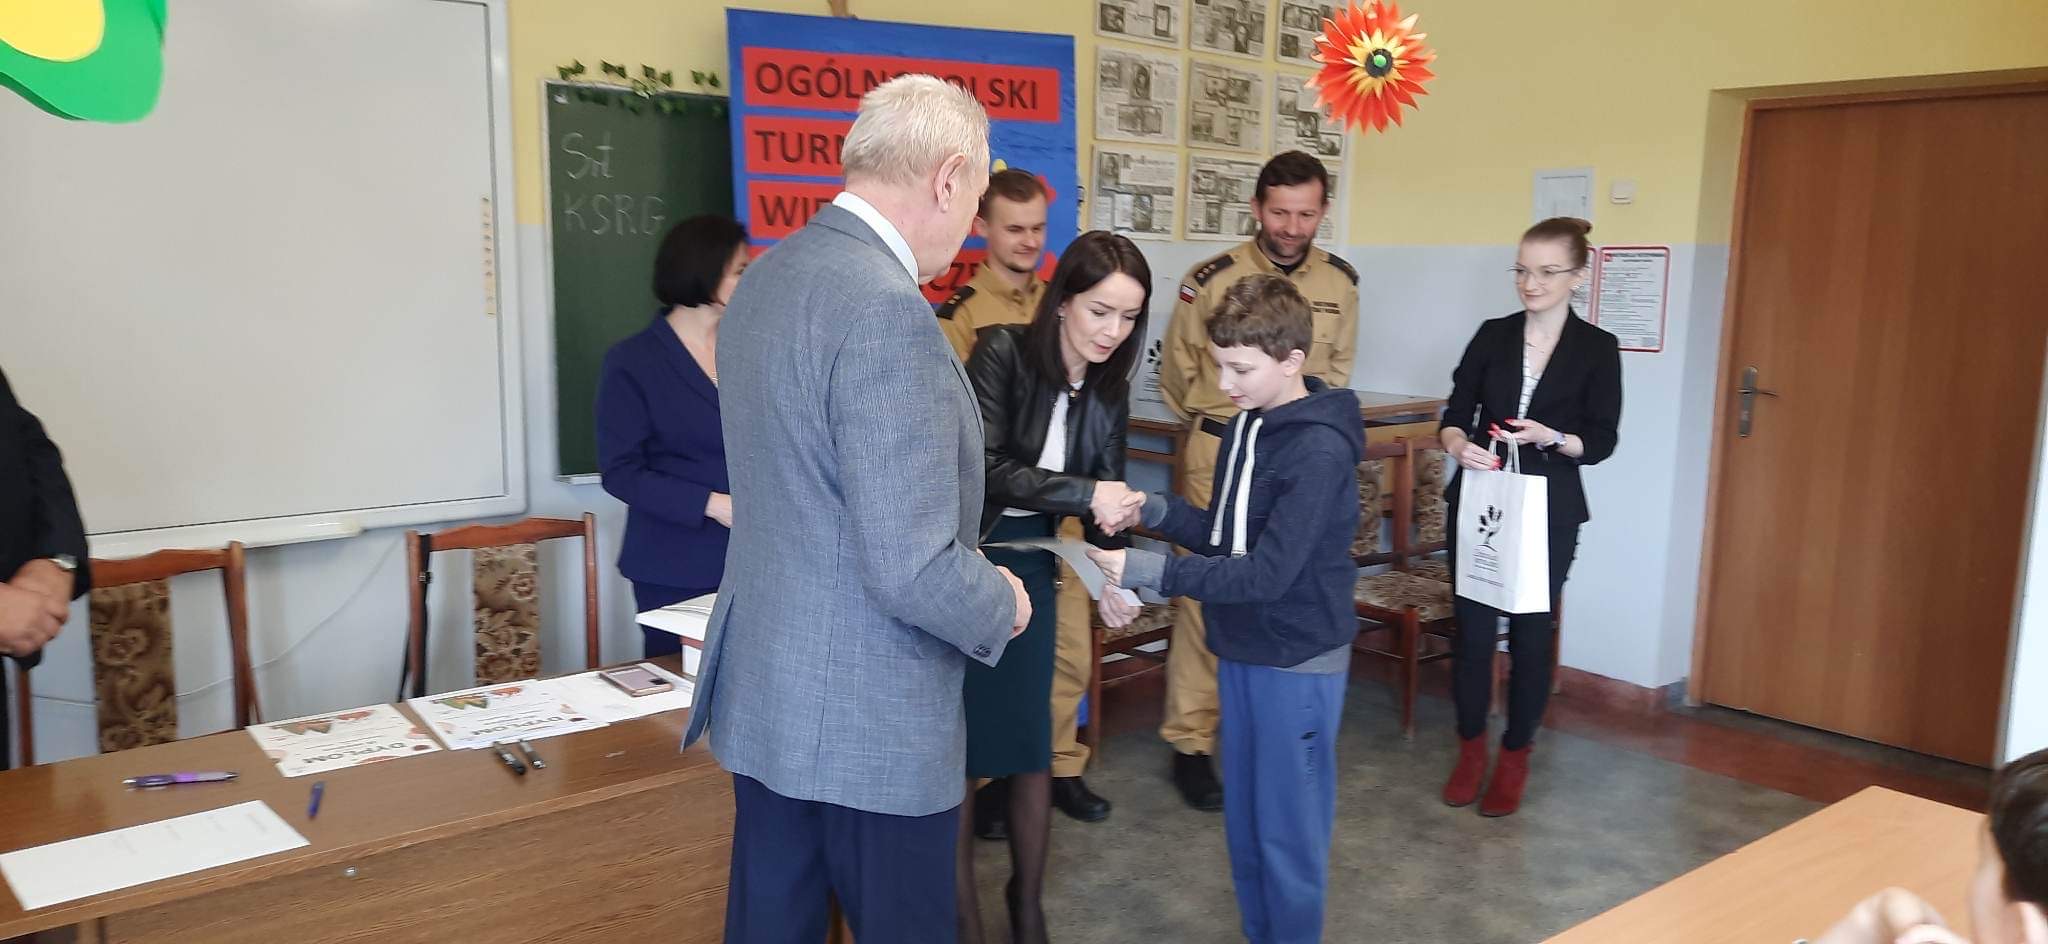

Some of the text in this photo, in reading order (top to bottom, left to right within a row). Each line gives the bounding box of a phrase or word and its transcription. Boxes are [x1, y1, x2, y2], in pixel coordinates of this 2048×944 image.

[563, 192, 666, 235] KSRG
[471, 715, 564, 736] DYPLOM
[302, 741, 407, 764] DYPLOM
